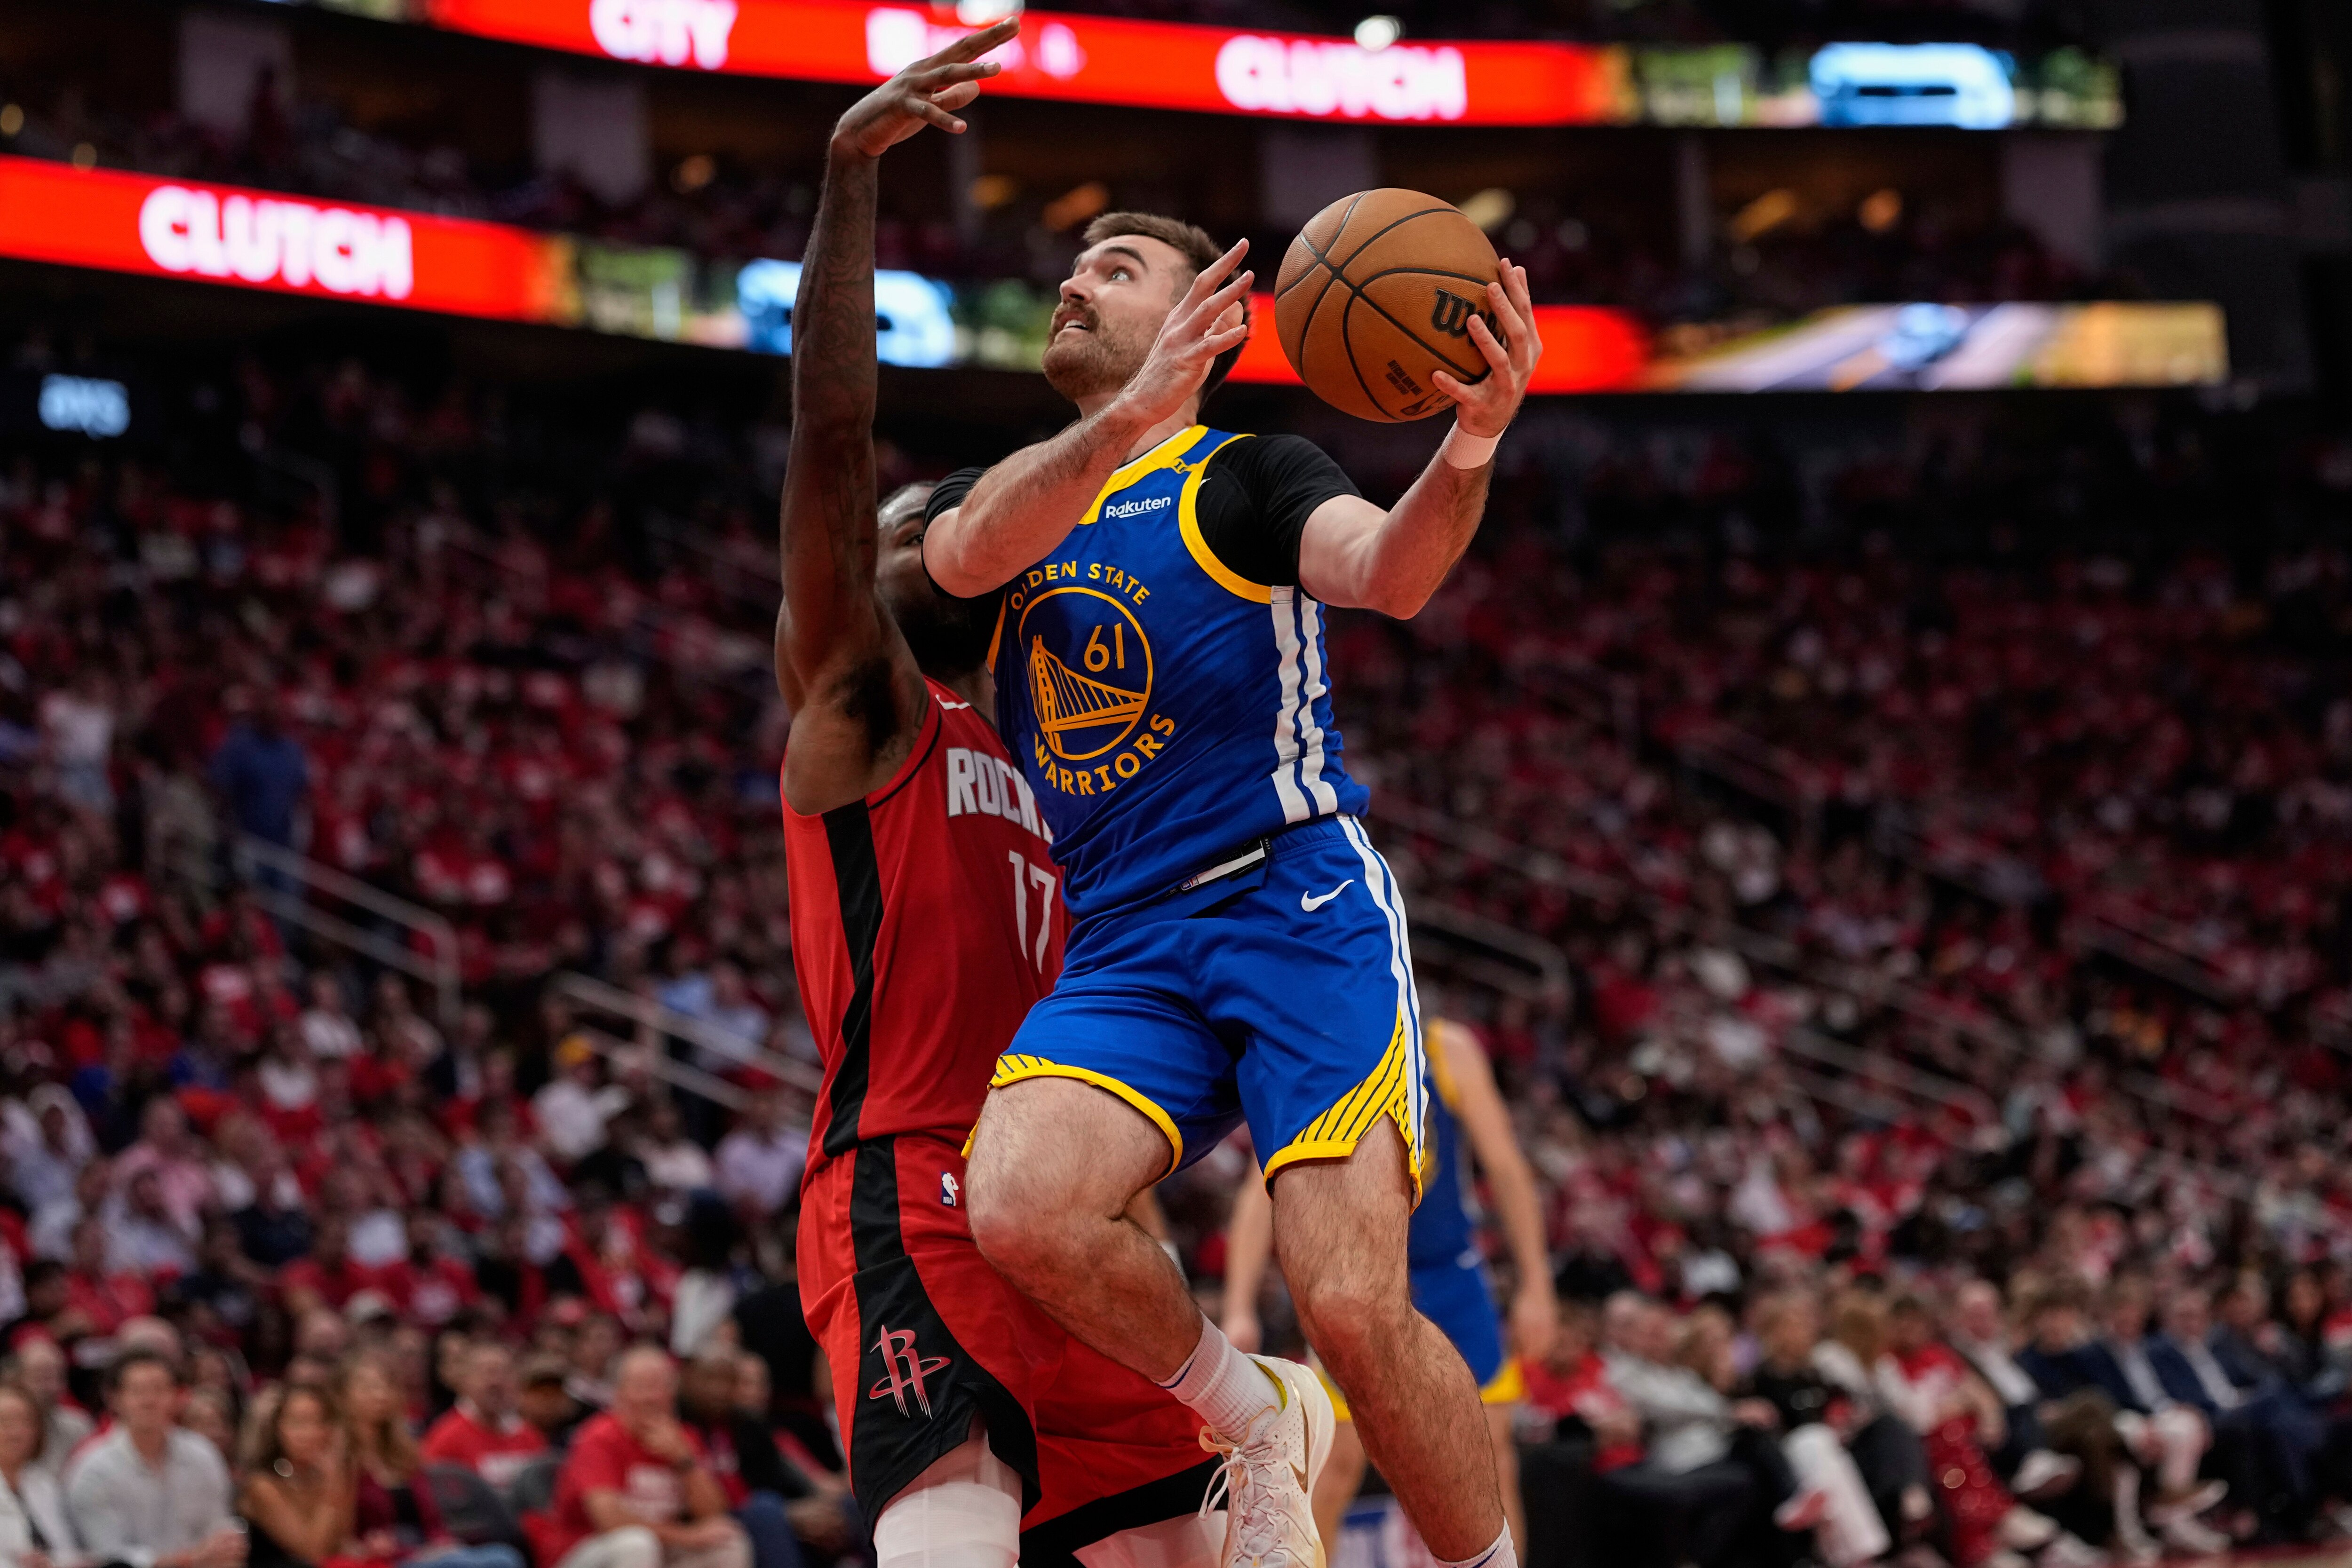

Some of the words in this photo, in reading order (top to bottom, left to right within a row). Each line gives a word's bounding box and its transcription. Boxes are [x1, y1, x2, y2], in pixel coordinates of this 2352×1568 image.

[1215, 35, 1467, 120] CLUTCH
[139, 184, 414, 300] CLUTCH
[1105, 496, 1171, 519] Rakuten
[1011, 560, 1077, 610] OLDEN
[1088, 562, 1151, 606] STATE
[1083, 622, 1125, 673] 61
[946, 747, 1054, 845] ROCK
[1034, 713, 1175, 796] WARRIORS
[1009, 849, 1057, 974] 17
[943, 1196, 953, 1204] NBA
